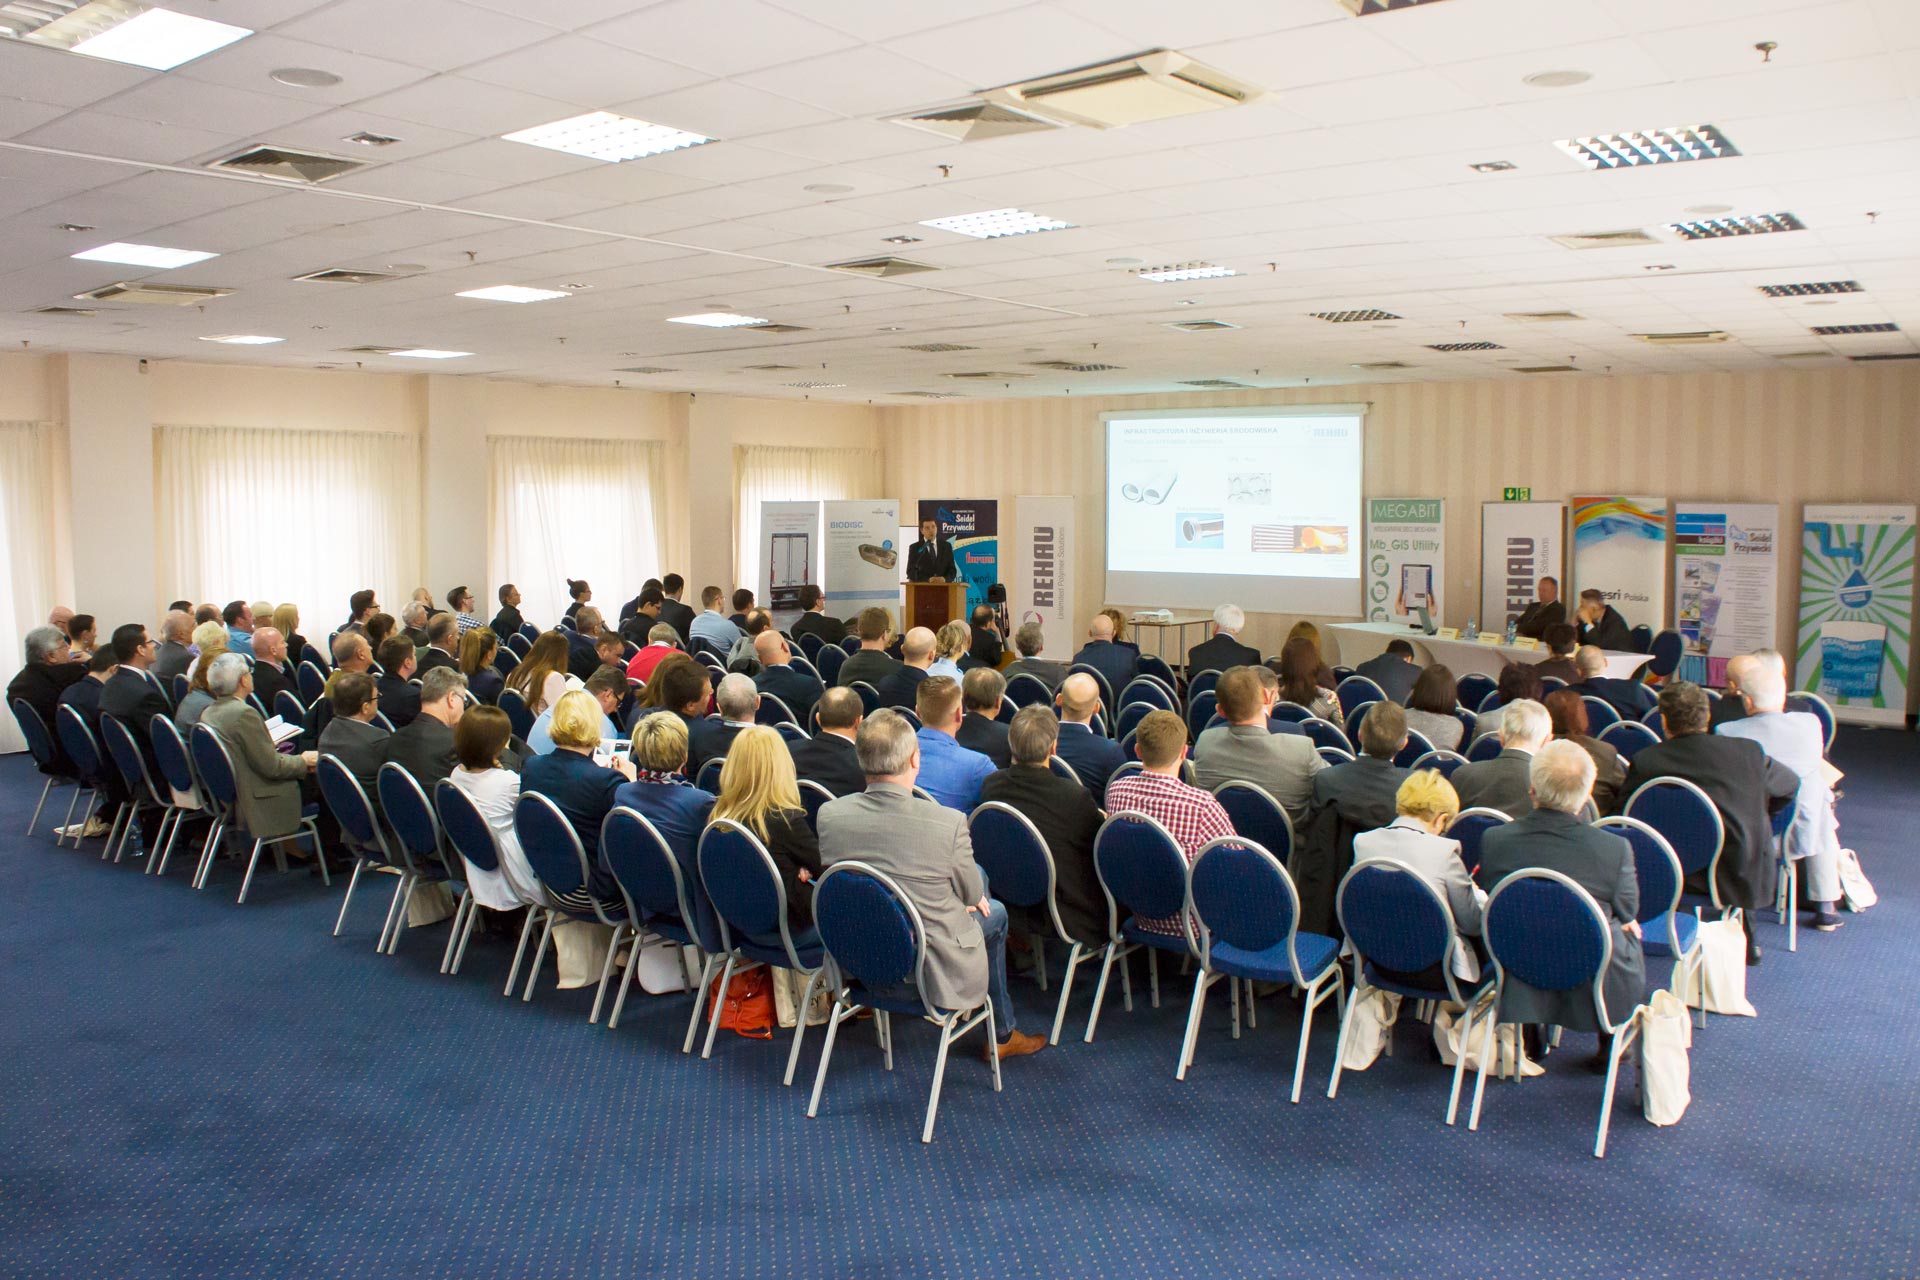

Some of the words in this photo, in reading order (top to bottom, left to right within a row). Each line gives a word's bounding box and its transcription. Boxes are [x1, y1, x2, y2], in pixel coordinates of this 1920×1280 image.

[1374, 503, 1437, 518] MEGABIT
[830, 521, 864, 529] BIODISC
[955, 513, 976, 523] Seidel
[1412, 539, 1440, 553] Utility
[1033, 526, 1054, 608] REHAU
